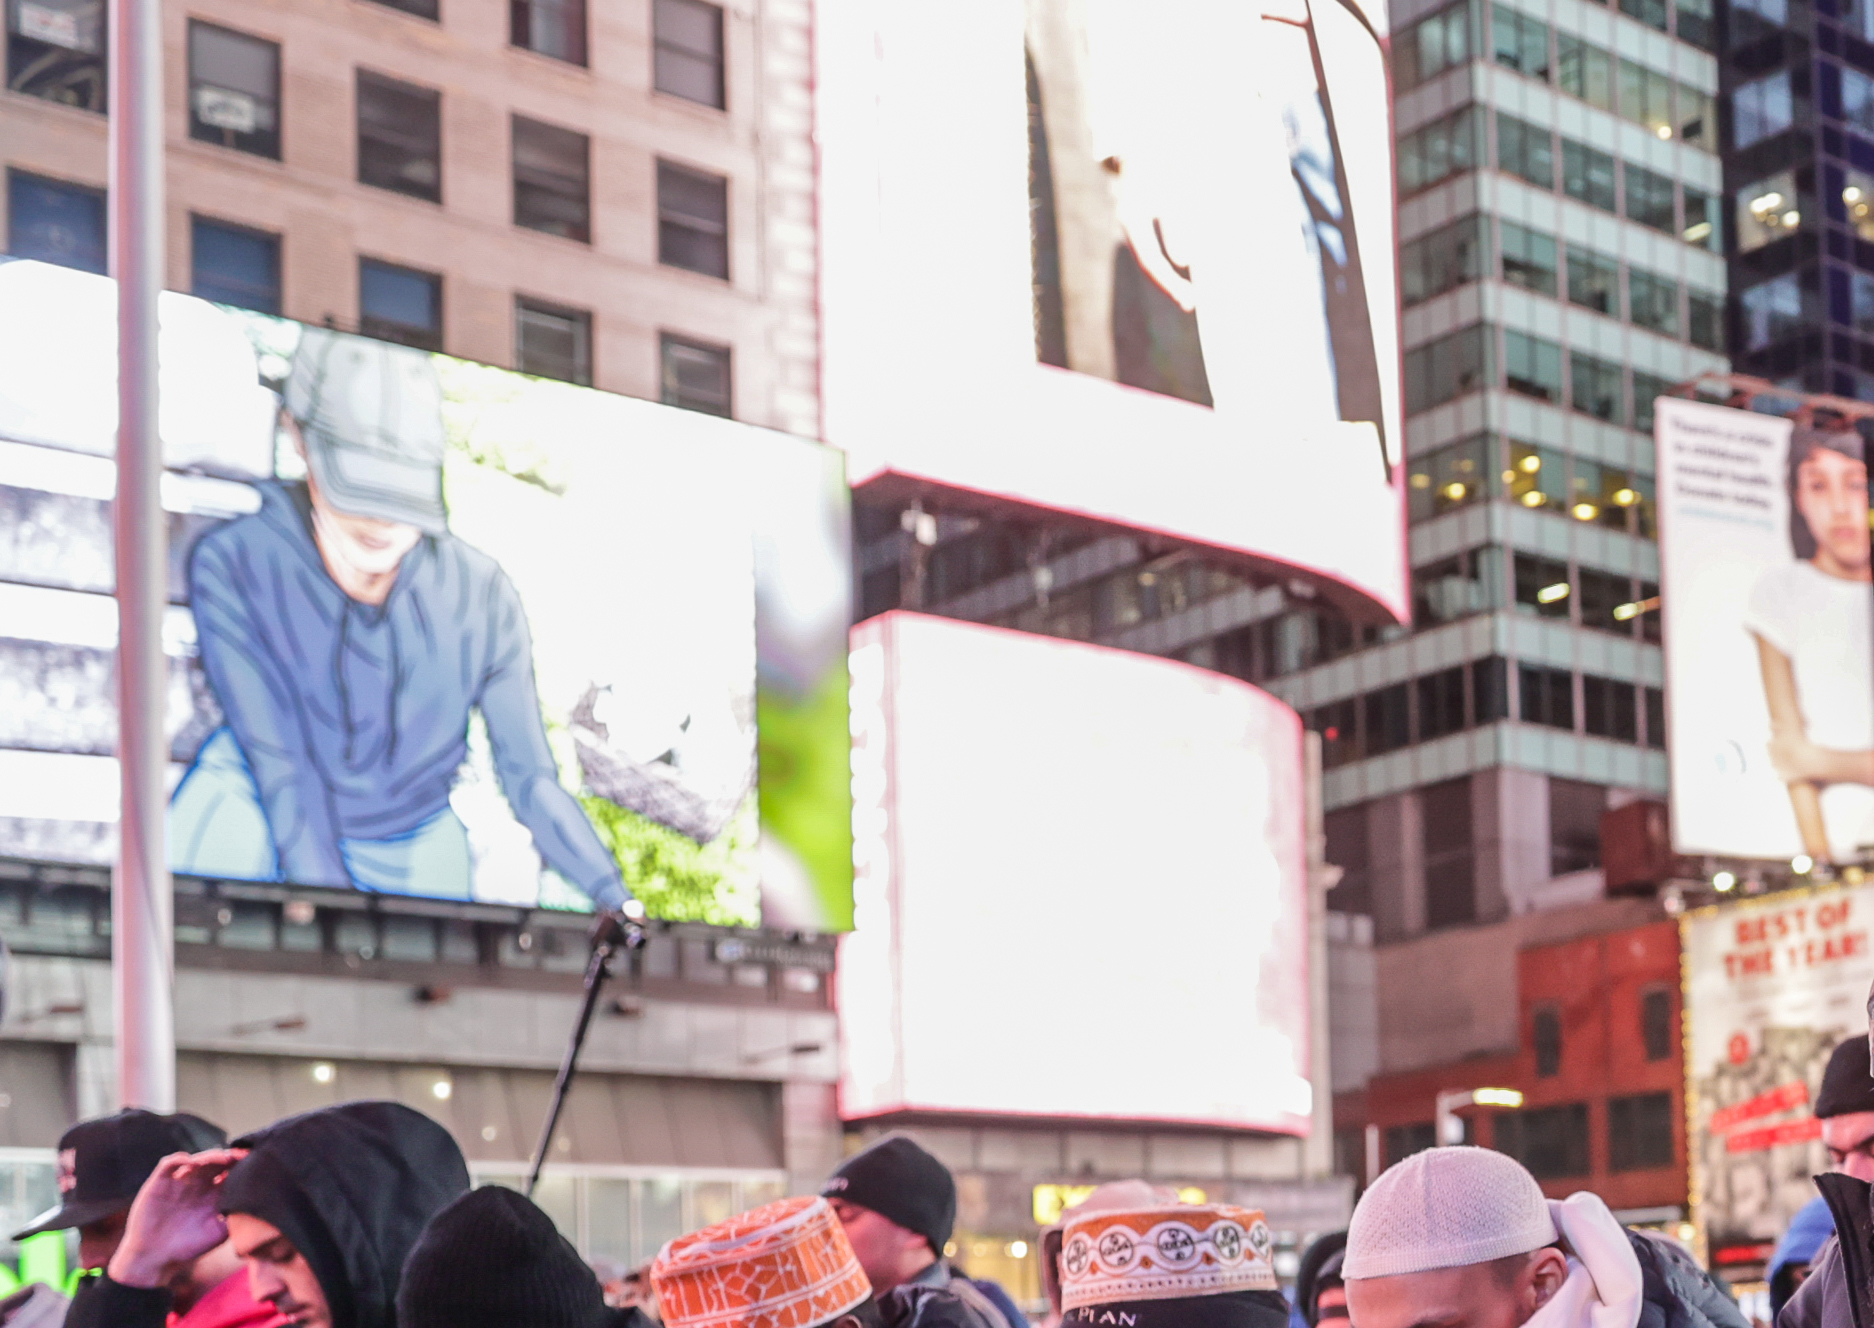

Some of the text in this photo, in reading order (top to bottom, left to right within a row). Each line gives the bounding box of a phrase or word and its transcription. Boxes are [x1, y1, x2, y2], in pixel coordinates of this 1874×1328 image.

[1736, 897, 1851, 946] BEST OF
[1724, 948, 1773, 979] THE
